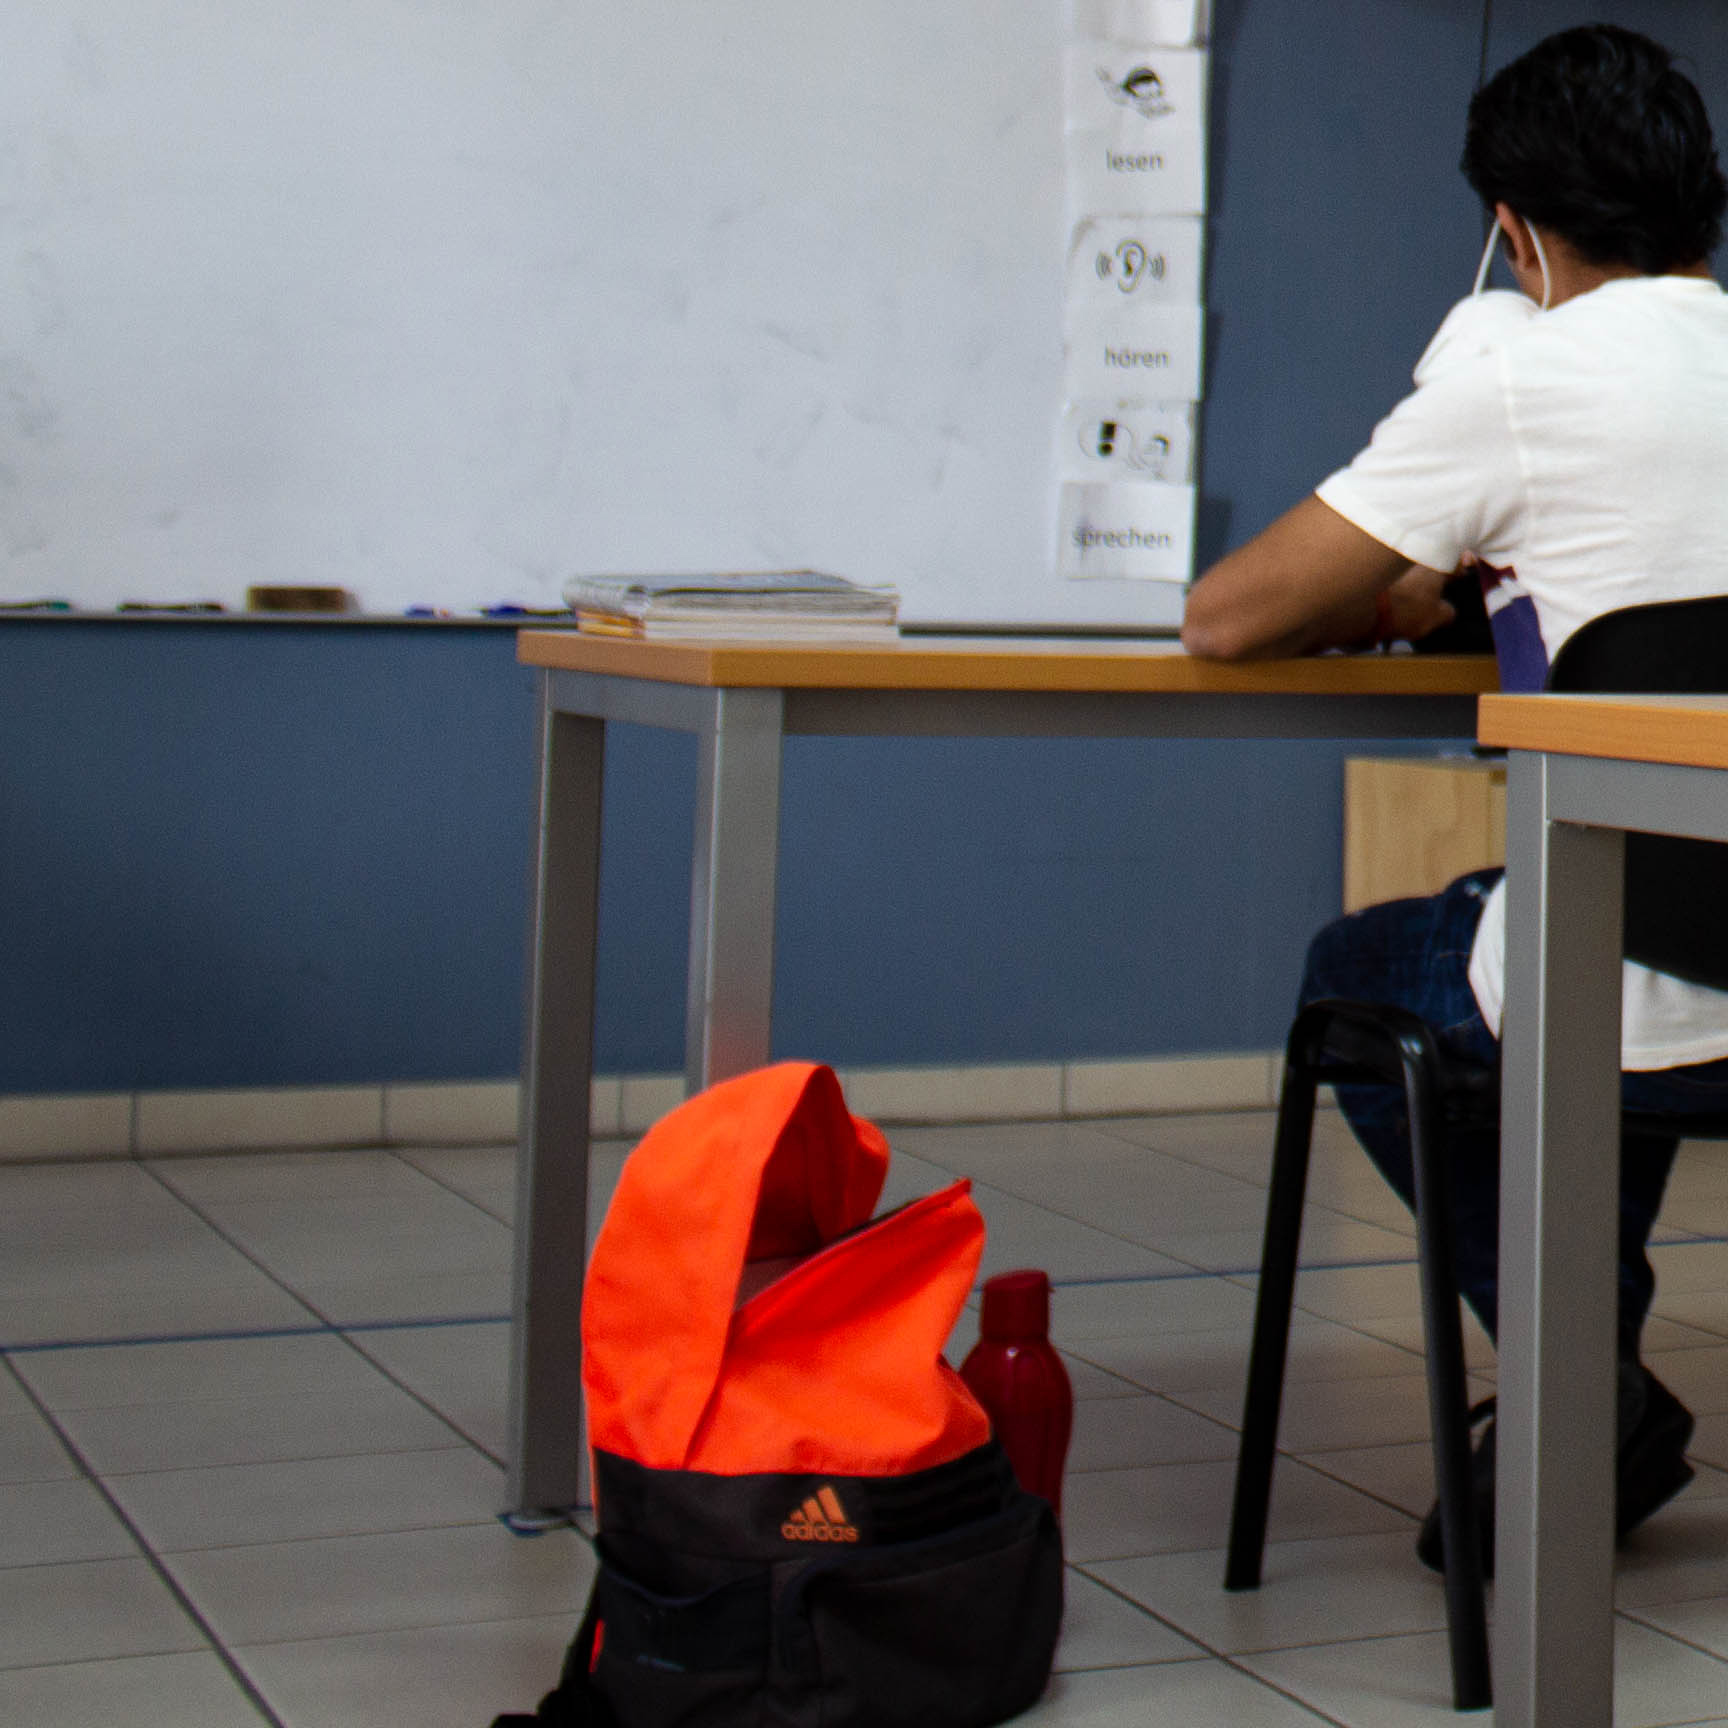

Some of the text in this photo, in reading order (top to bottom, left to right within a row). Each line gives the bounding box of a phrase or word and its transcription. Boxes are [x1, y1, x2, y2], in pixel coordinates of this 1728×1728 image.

[1106, 150, 1163, 171] lesen
[1072, 525, 1171, 553] sprechen
[781, 1521, 858, 1542] adidas
